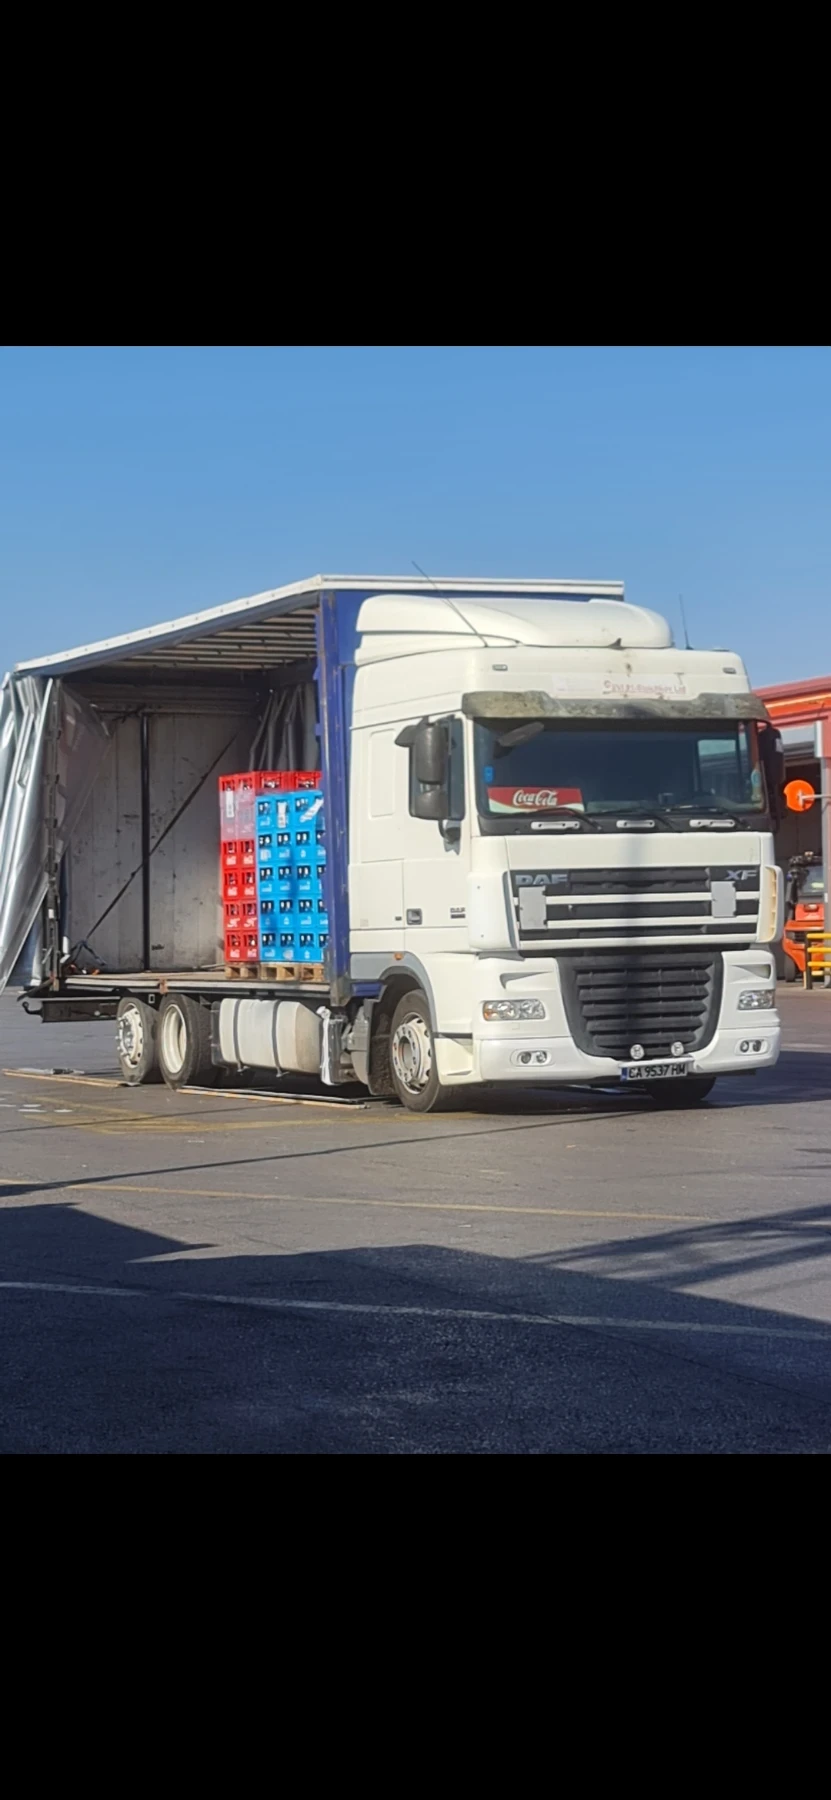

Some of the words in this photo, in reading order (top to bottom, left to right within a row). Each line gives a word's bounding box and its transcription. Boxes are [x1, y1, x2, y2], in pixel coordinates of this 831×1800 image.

[515, 874, 568, 885] DAF
[725, 869, 757, 880] XF
[629, 1067, 643, 1078] CA
[645, 1064, 670, 1077] 9537
